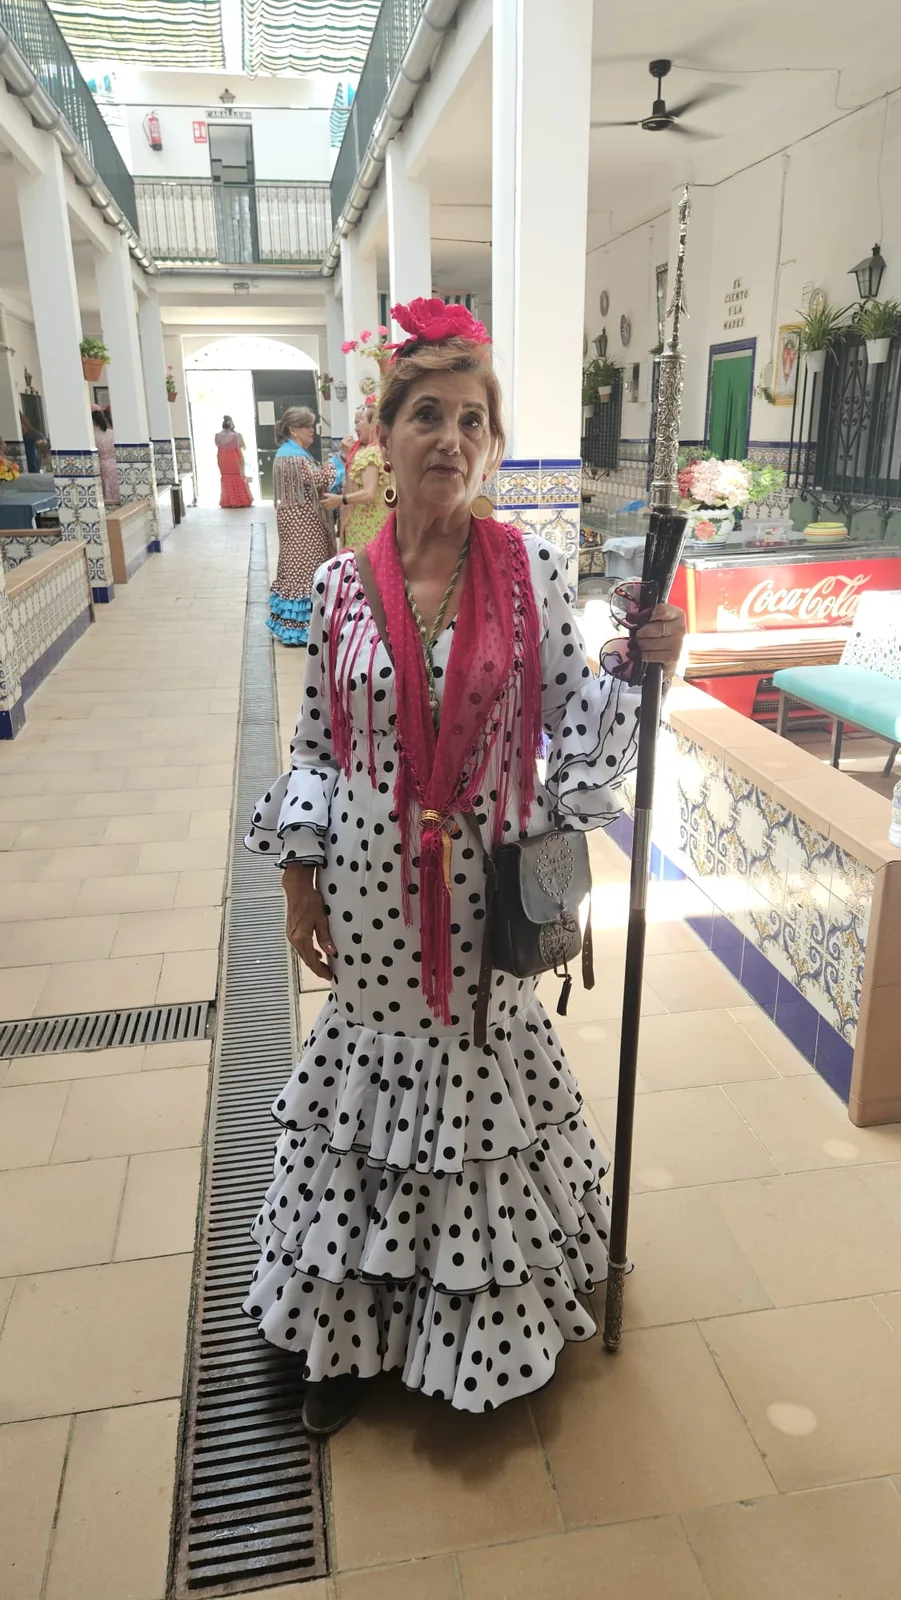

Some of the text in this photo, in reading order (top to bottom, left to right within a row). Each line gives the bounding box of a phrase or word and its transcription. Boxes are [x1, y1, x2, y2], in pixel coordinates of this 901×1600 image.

[733, 278, 741, 289] EL
[724, 289, 749, 303] CIENTO
[733, 304, 742, 315] LA
[723, 317, 745, 330] MADRE
[739, 573, 873, 624] Coca-Cola
